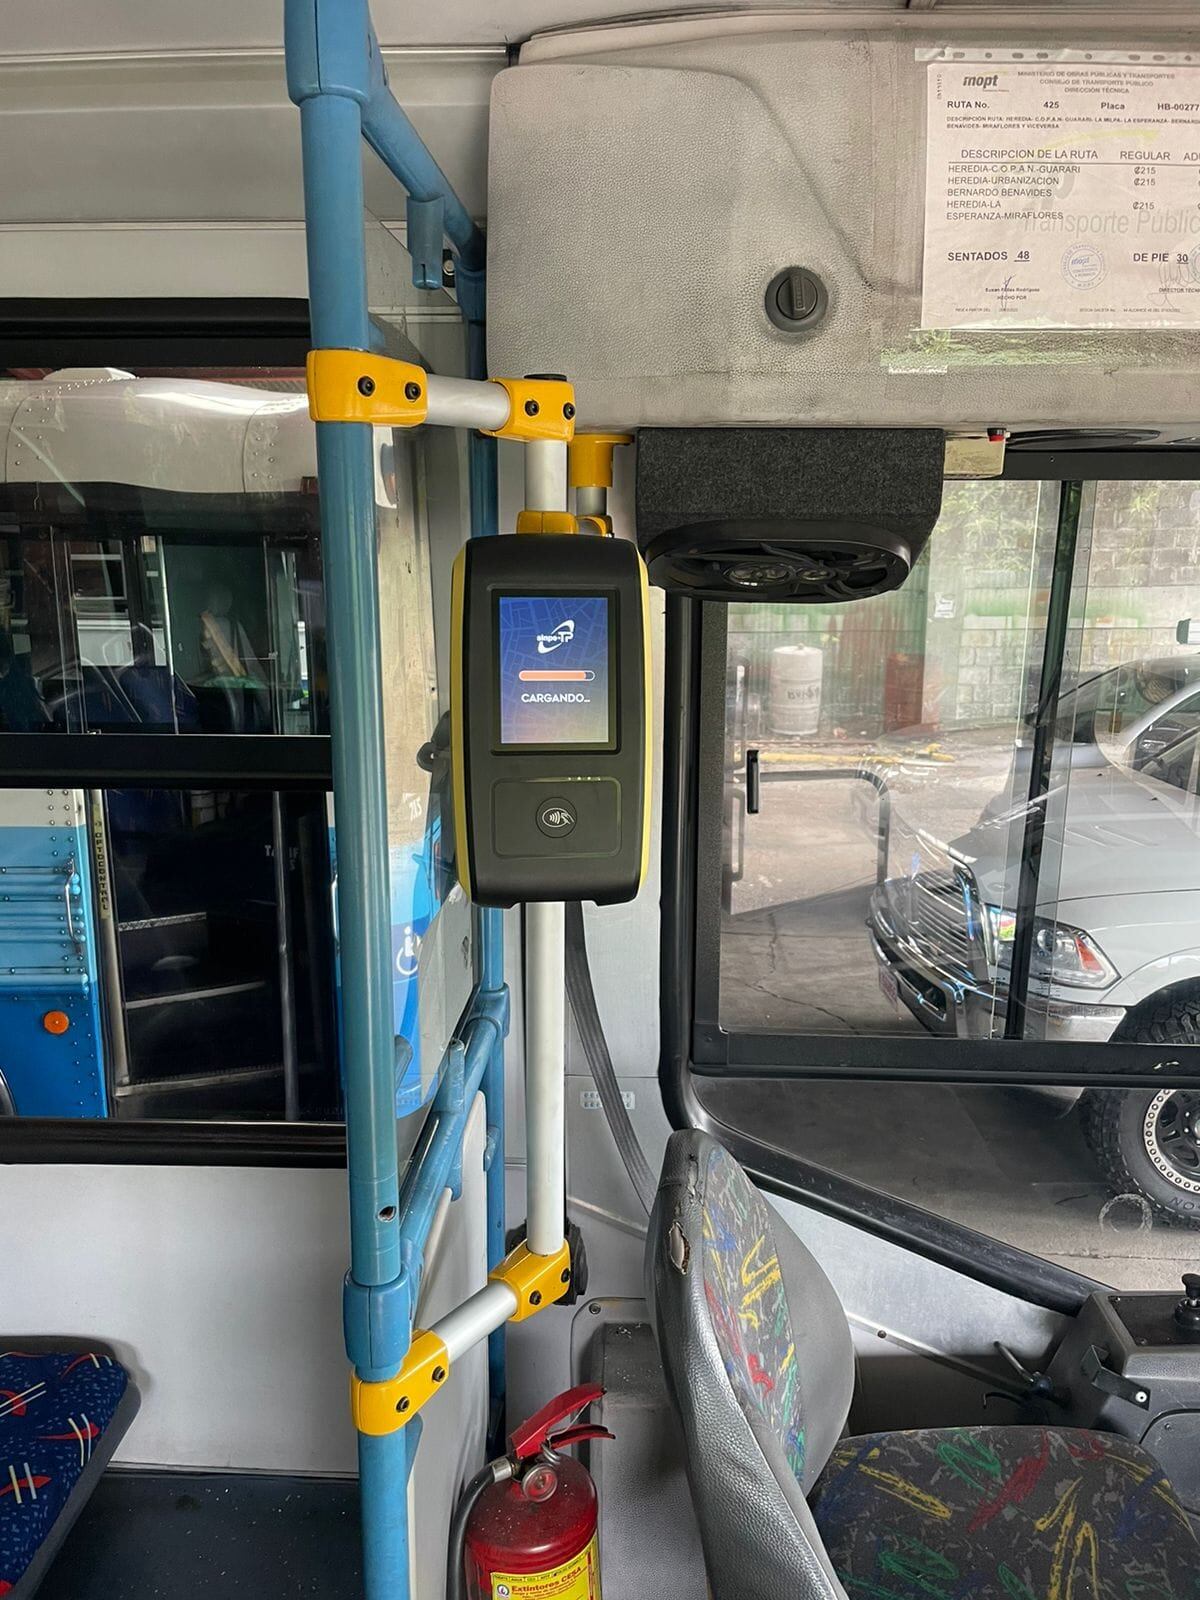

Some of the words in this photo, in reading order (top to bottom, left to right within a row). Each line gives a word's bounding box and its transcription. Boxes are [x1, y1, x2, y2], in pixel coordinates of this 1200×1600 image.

[947, 101, 972, 109] RUTA
[974, 101, 990, 109] No.
[1043, 101, 1060, 109] 425
[1100, 102, 1126, 110] Placa
[961, 149, 1035, 159] DESCRIPCION
[1038, 149, 1052, 159] DE
[1054, 150, 1068, 159] LA
[1070, 150, 1099, 159] RUTA
[1119, 151, 1171, 160] REGULAR
[947, 176, 1060, 185] HEREDIA-URBANIZACION
[947, 188, 999, 197] BERNARDO
[1001, 188, 1053, 197] BENAVIDES
[946, 200, 1002, 209] HEREDIA-LA
[946, 211, 1064, 220] ESPERANZA-MIRAFLORES
[947, 251, 1009, 261] SENTADOS
[1016, 250, 1030, 260] 48
[1133, 252, 1149, 263] DE
[1151, 252, 1170, 263] PIE
[1176, 253, 1189, 263] 30
[512, 1581, 560, 1592] Extintores
